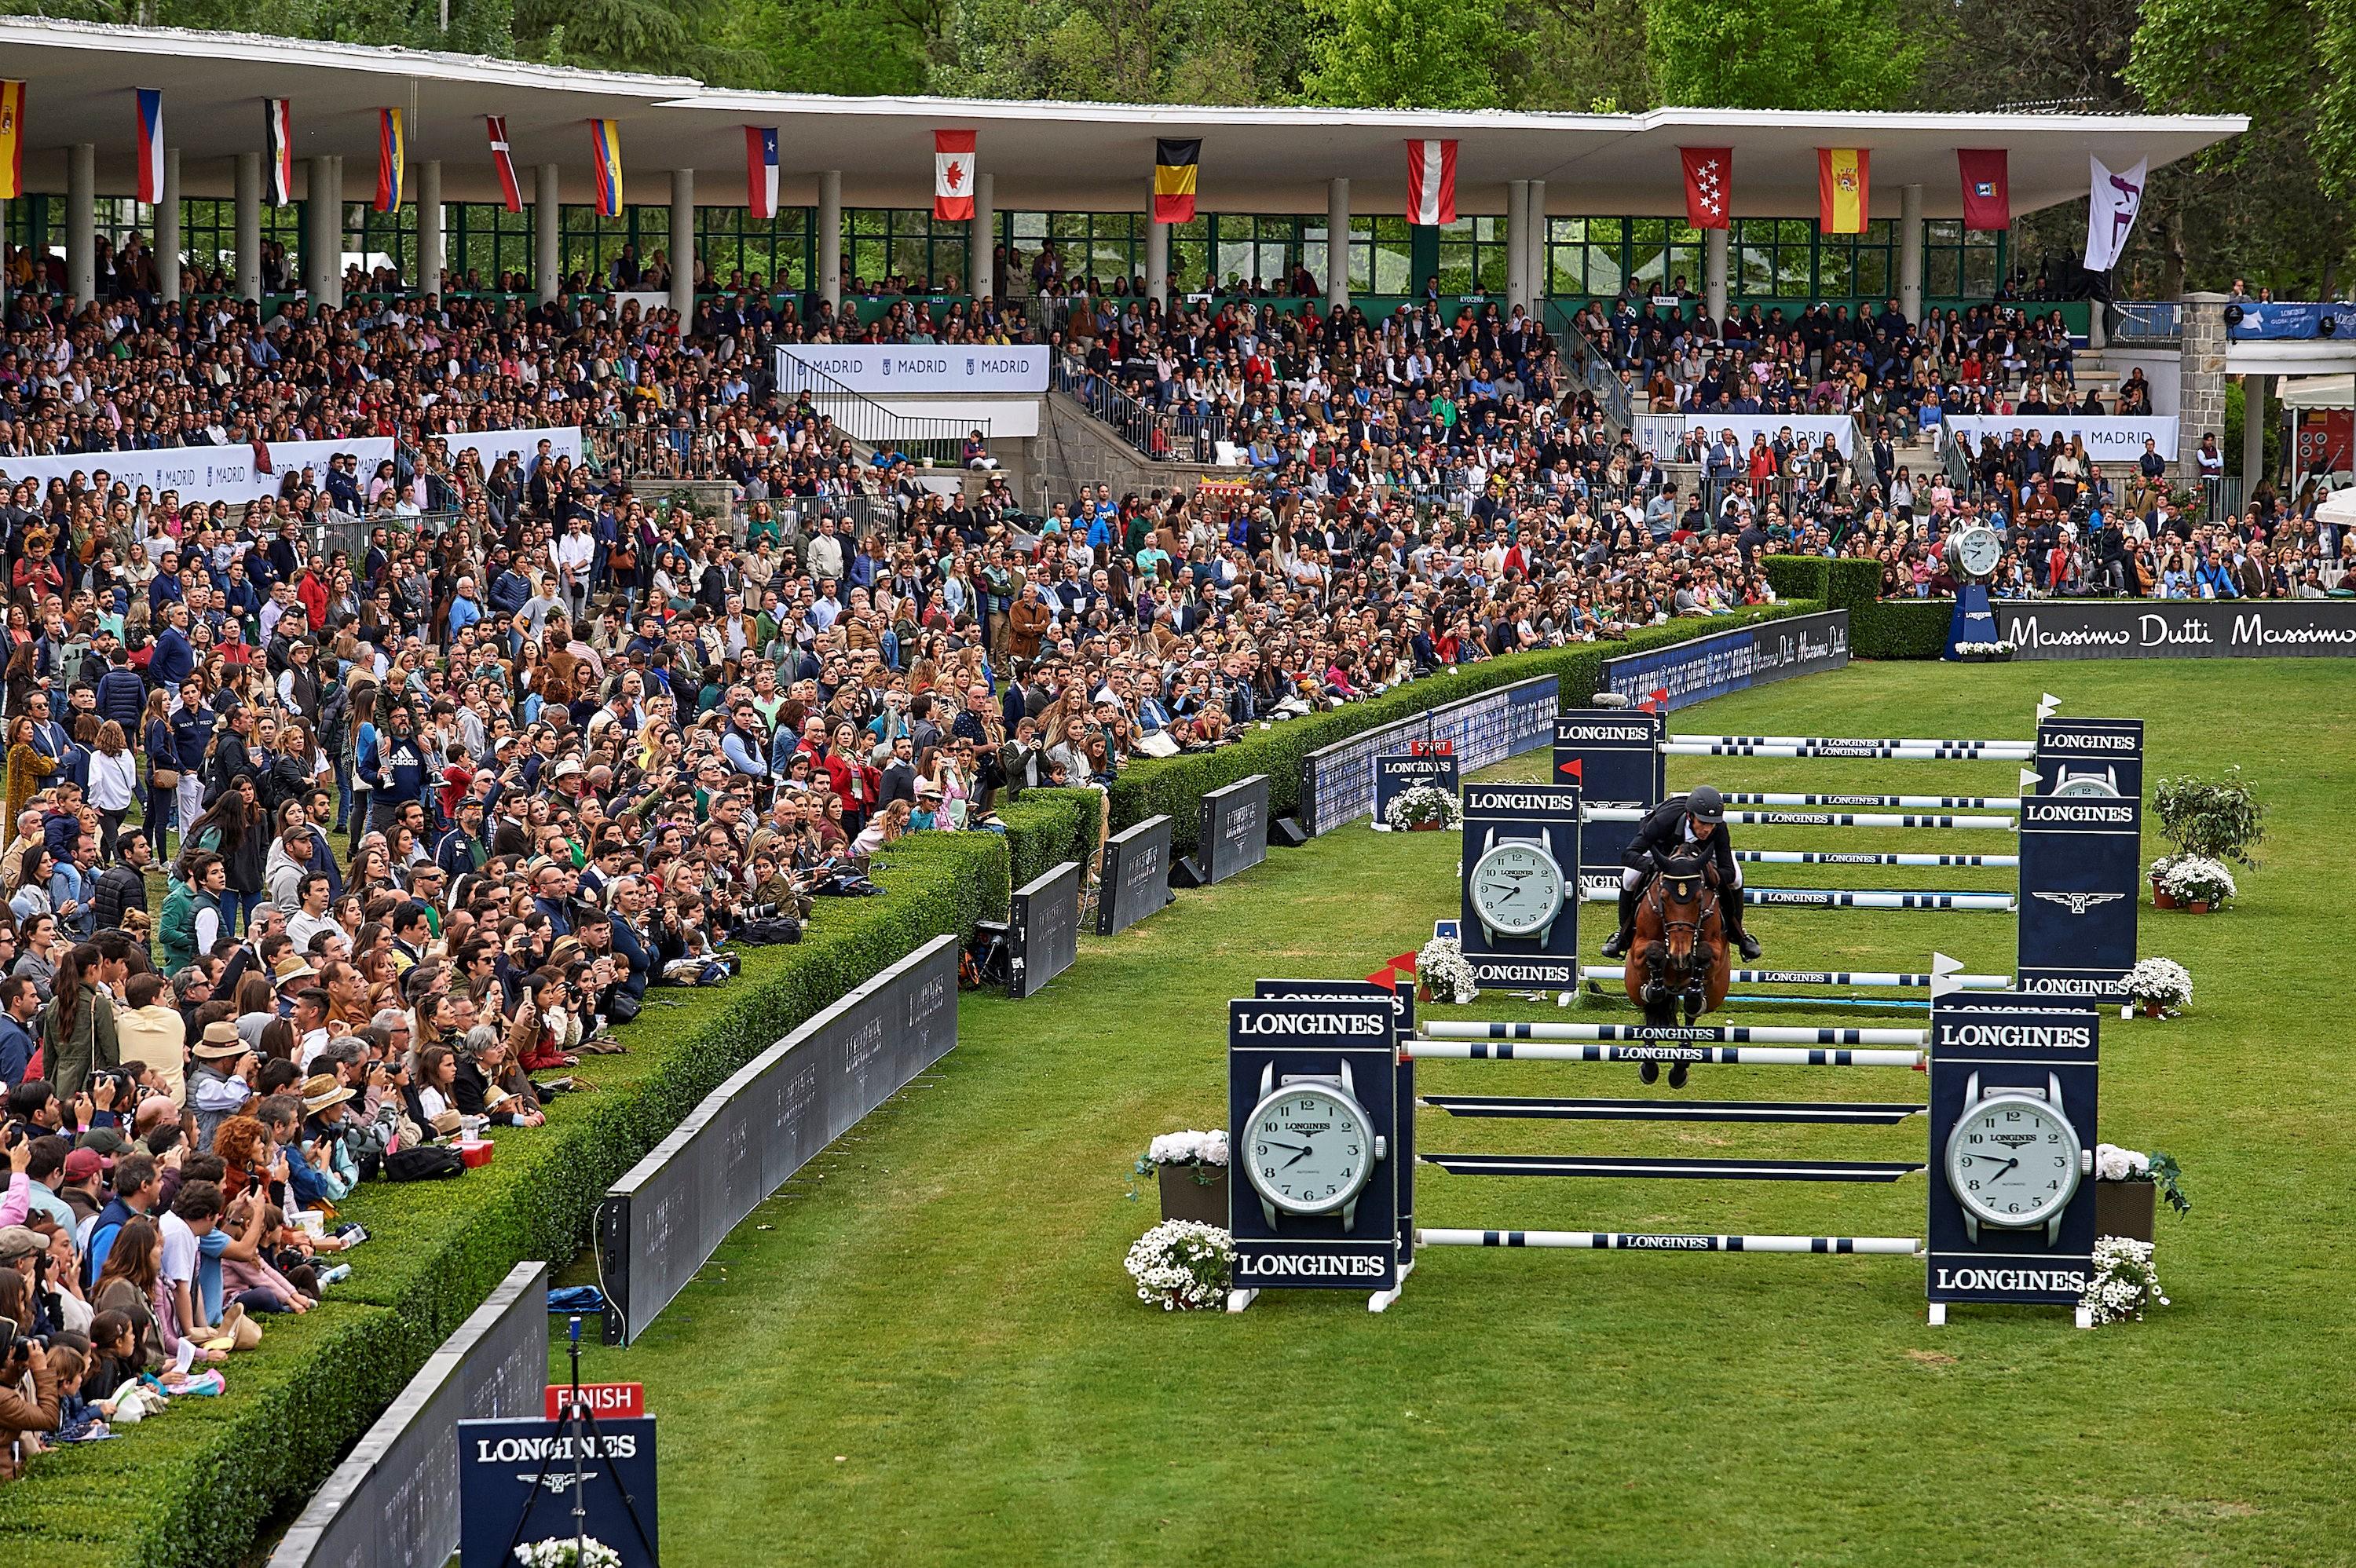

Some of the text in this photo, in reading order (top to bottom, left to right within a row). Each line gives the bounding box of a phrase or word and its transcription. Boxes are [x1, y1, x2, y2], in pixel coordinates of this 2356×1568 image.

[813, 360, 863, 373] MADRID
[898, 360, 946, 373] MADRID
[982, 359, 1030, 373] MADRID
[2091, 432, 2152, 444] MADRID
[166, 470, 195, 487] MADRID
[216, 467, 245, 484] MADRID
[2008, 613, 2356, 649] Massimo Dutti Massimo
[1798, 625, 1846, 663] Massimo Dutti
[1557, 726, 1649, 740] LONGINES
[1827, 738, 1879, 747] LONGINES
[2043, 733, 2135, 750] LONGINES
[1819, 747, 1872, 757] LONGINES
[389, 757, 419, 766] adidas
[1469, 793, 1573, 812] LONGINES
[1827, 795, 1879, 805] LONGINES
[1768, 813, 1829, 824] LONGINES
[2027, 805, 2133, 822] LONGINES
[1824, 853, 1876, 863] LONGINES
[1767, 893, 1827, 903] LONGINES
[1765, 972, 1825, 982] LONGINES
[2024, 978, 2130, 995] LONGINES
[1238, 1013, 1385, 1036] LONGINES
[1632, 1027, 1715, 1040] LONGINES
[1941, 1025, 2091, 1048] LONGINES
[1618, 1047, 1703, 1060] LONGINES
[1301, 1100, 1315, 1110] 12
[1280, 1106, 1289, 1117] 11
[1329, 1106, 1333, 1117] 1
[2006, 1112, 2021, 1122] 12
[1264, 1122, 1278, 1132] 10
[1341, 1122, 1352, 1132] 2
[1985, 1118, 1995, 1128] 11
[2035, 1118, 2040, 1128] 1
[1969, 1134, 1983, 1144] 10
[2048, 1134, 2058, 1144] 2
[1257, 1145, 1268, 1155] 9
[1348, 1145, 1359, 1155] 3
[1962, 1157, 1972, 1168] 9
[2054, 1157, 2065, 1167] 3
[1264, 1168, 1275, 1178] 8
[1340, 1168, 1352, 1178] 4
[1282, 1185, 1291, 1195] 7
[1326, 1185, 1336, 1194] 5
[1969, 1180, 1980, 1190] 8
[2046, 1180, 2058, 1190] 4
[1304, 1191, 1314, 1201] 6
[1986, 1197, 1996, 1207] 7
[2032, 1197, 2042, 1207] 5
[2008, 1203, 2019, 1213] 6
[1626, 1236, 1709, 1249] LONGINES
[1240, 1255, 1385, 1277] LONGINES
[1937, 1269, 2085, 1292] LONGINES
[557, 1387, 632, 1409] FINISH
